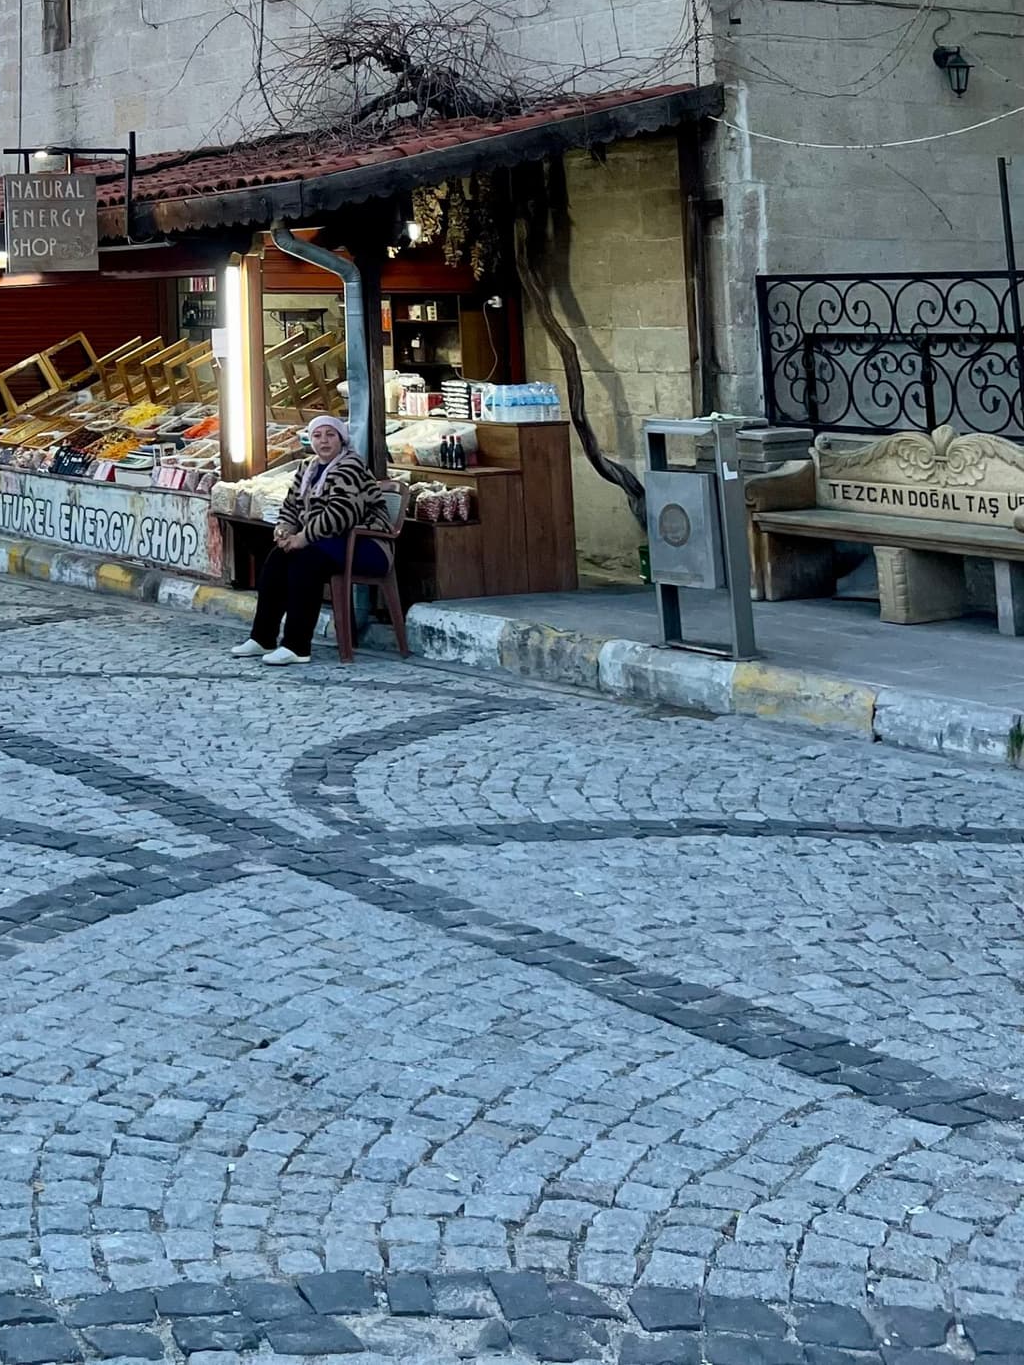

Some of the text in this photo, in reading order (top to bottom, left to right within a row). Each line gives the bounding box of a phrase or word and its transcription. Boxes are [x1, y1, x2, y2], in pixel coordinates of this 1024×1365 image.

[11, 179, 85, 199] NATURAL
[12, 208, 86, 228] ENERGY
[12, 237, 57, 257] SHOP
[828, 483, 904, 505] TEZCAN
[908, 489, 961, 511] DOĞAL
[965, 495, 1000, 518] TAŞ
[59, 502, 136, 554] ENERGY
[138, 516, 198, 566] SHOP
